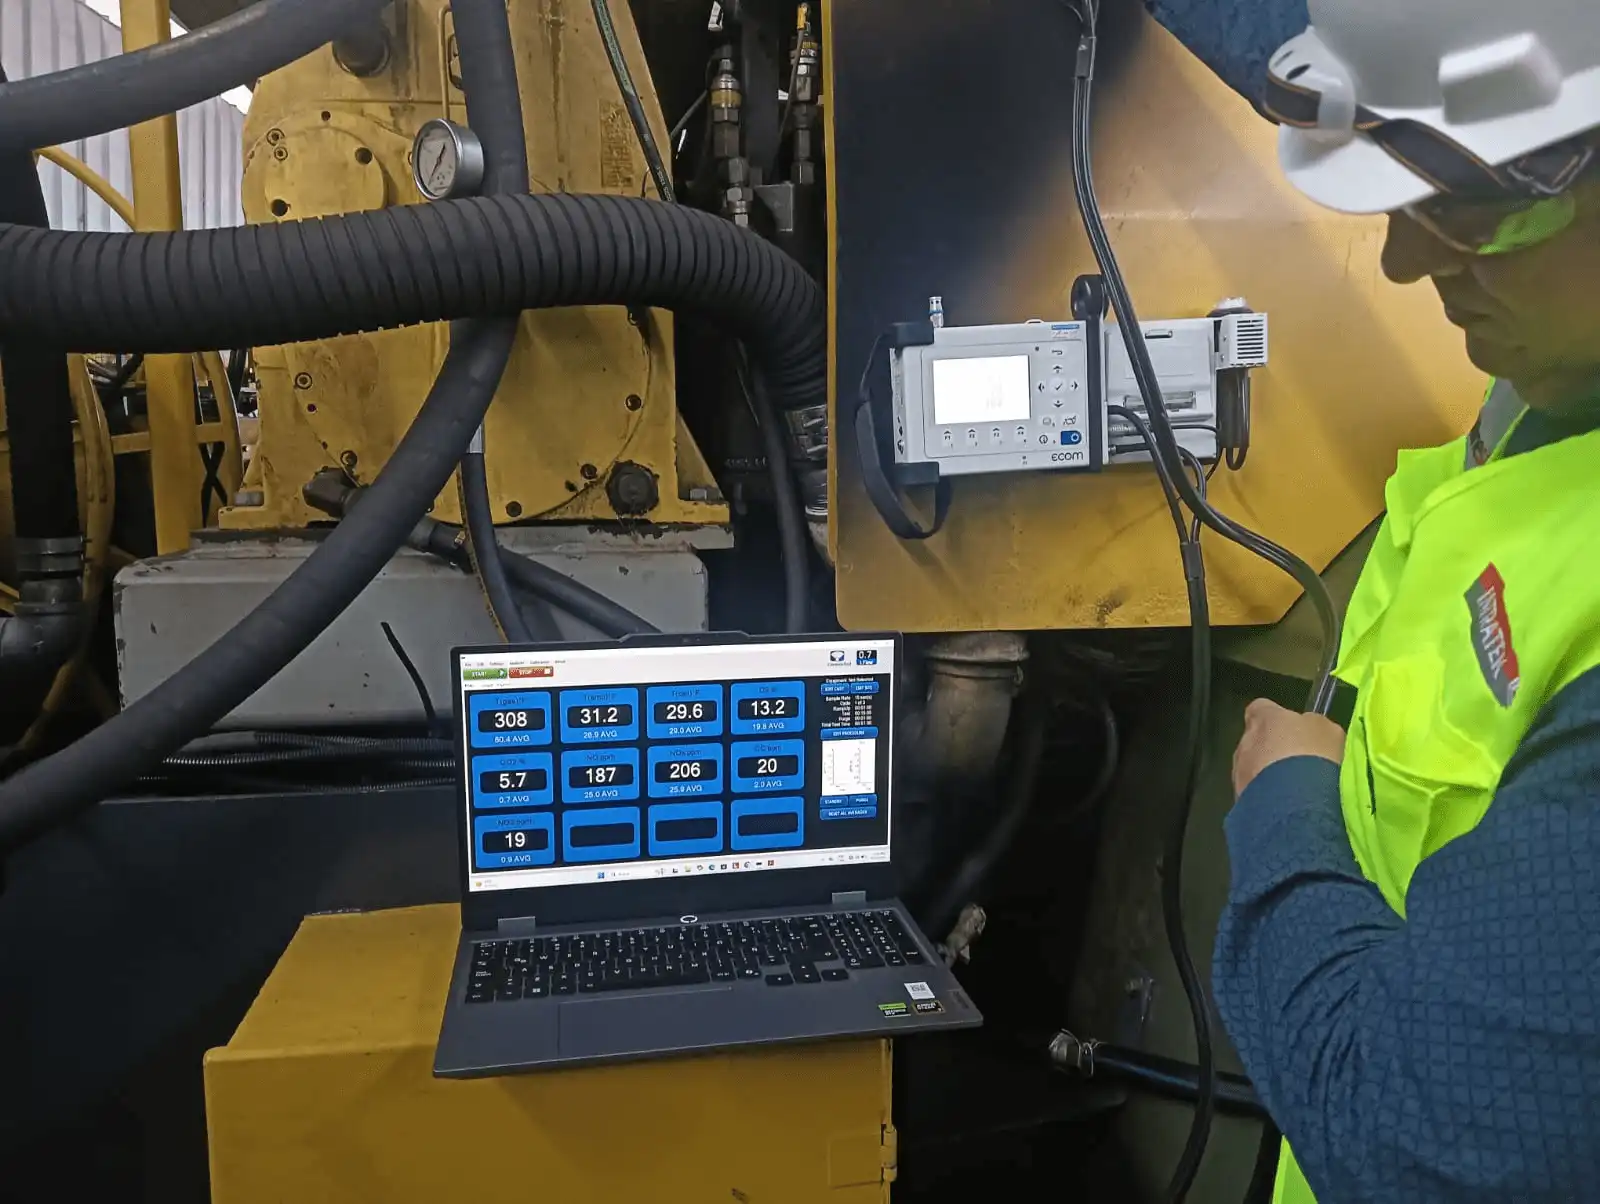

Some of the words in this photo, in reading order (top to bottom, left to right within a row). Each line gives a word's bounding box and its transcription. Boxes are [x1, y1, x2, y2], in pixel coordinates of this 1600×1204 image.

[858, 650, 872, 659] 0.7
[666, 703, 703, 720] 29.6
[751, 699, 785, 716] 13.2
[494, 711, 527, 728] 308
[580, 707, 618, 724] 31.2
[686, 725, 703, 734] AVG
[768, 721, 785, 729] AVG
[512, 734, 530, 742] AVG
[600, 729, 618, 738] AVG
[669, 762, 701, 779] 206
[757, 758, 778, 774] 20
[585, 767, 617, 784] 187
[499, 772, 527, 789] 5.7
[766, 780, 783, 788] AVG
[686, 784, 702, 792] AVG
[601, 790, 619, 798] AVG
[512, 795, 530, 803] AVG
[504, 832, 526, 849] 19
[514, 855, 531, 863] AVG
